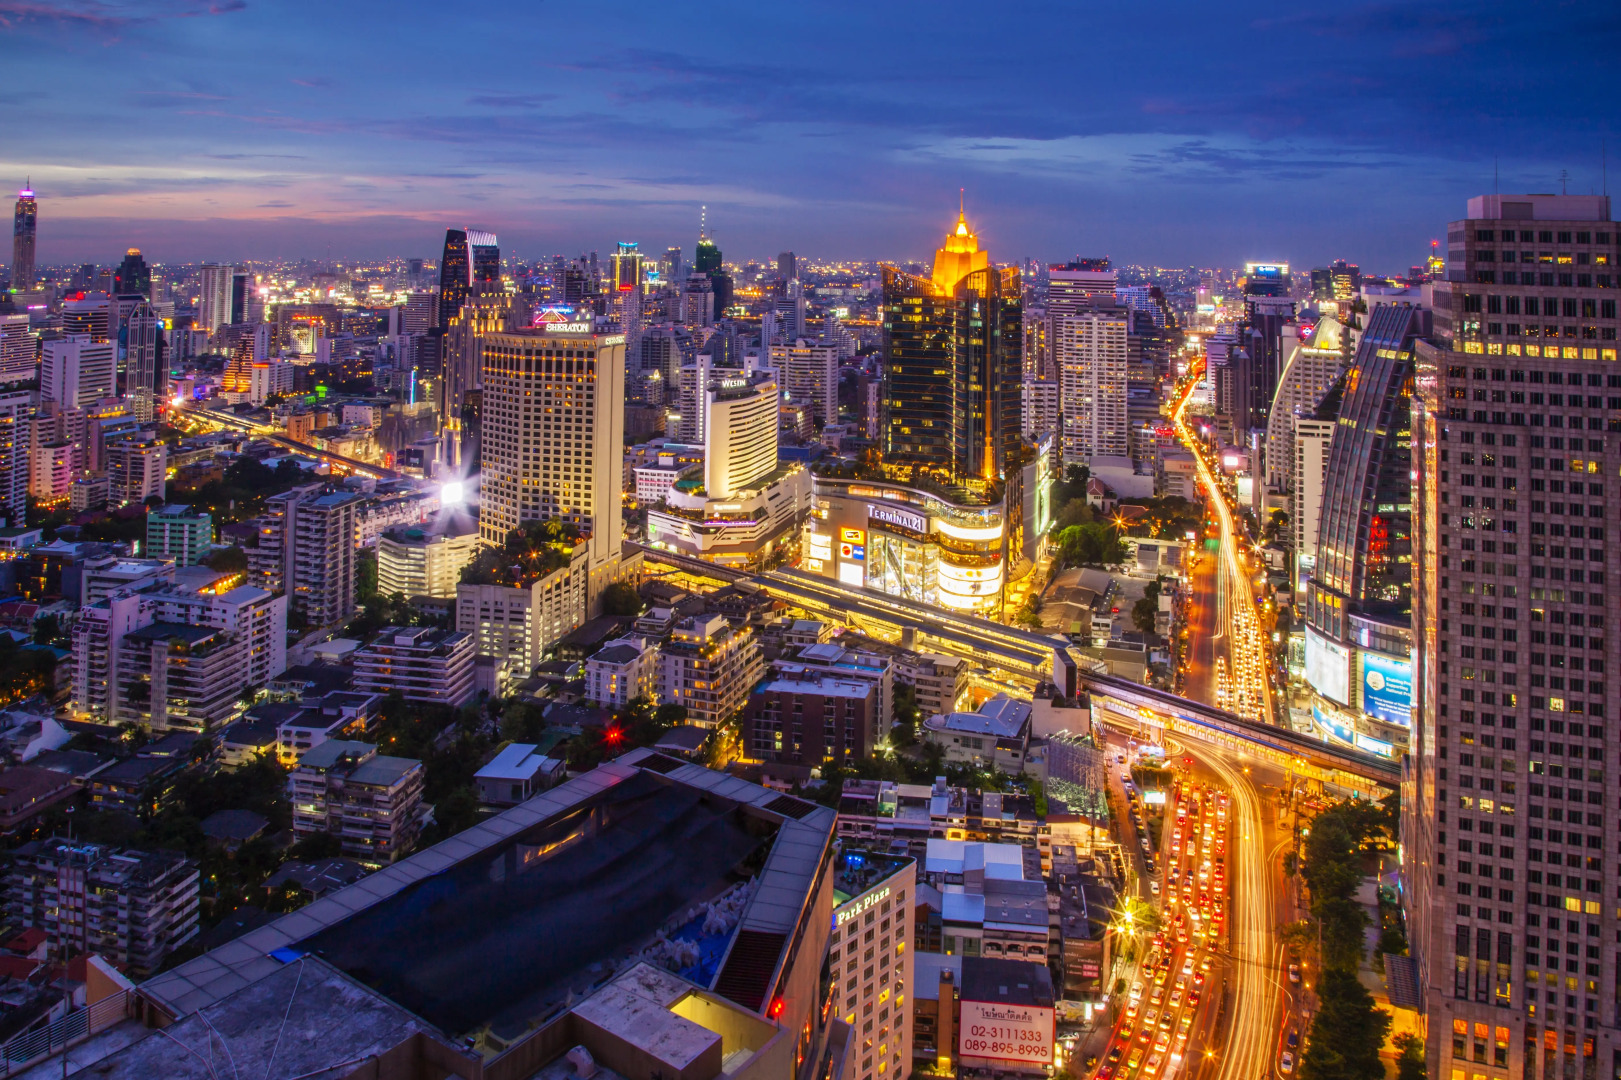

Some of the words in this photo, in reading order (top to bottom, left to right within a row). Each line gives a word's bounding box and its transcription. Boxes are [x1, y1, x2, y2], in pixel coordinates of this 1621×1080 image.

[545, 322, 589, 332] SHERATON
[838, 902, 863, 925] Park
[864, 887, 890, 910] Plaza
[971, 1025, 1042, 1042] 02-3111333
[965, 1039, 1048, 1057] 089-895-8995
